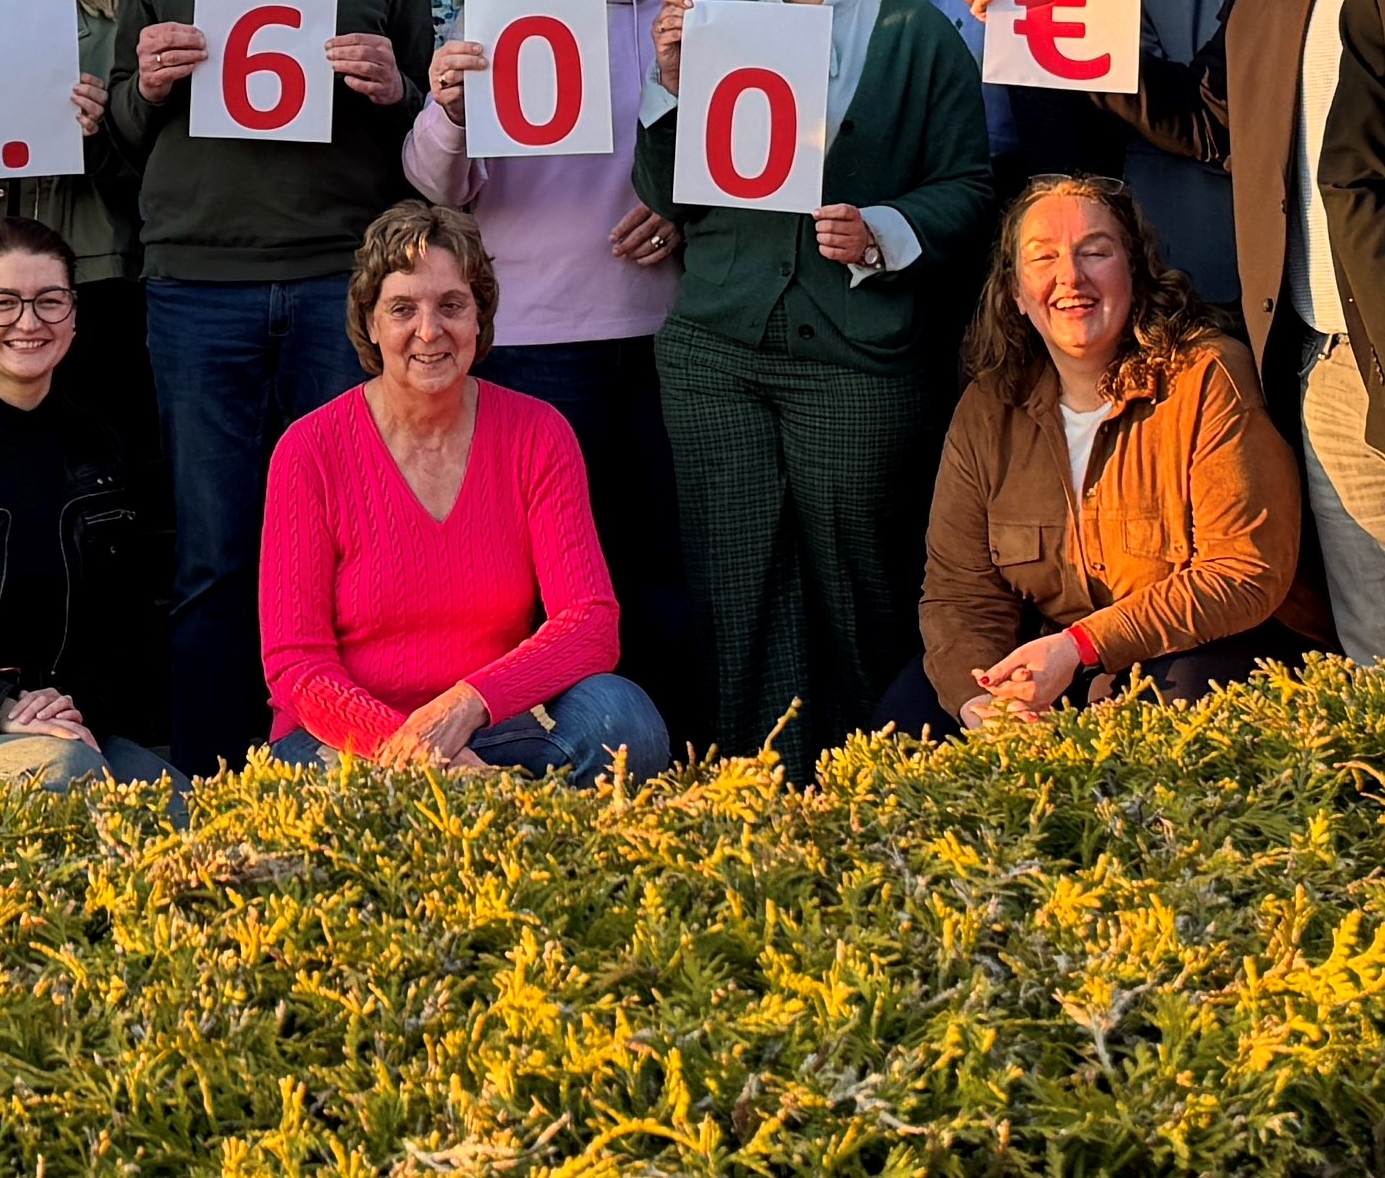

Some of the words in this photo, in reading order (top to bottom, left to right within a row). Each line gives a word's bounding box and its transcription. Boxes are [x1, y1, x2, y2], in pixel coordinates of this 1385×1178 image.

[222, 5, 306, 130] 6
[492, 16, 583, 146] 0
[705, 67, 797, 199] 0
